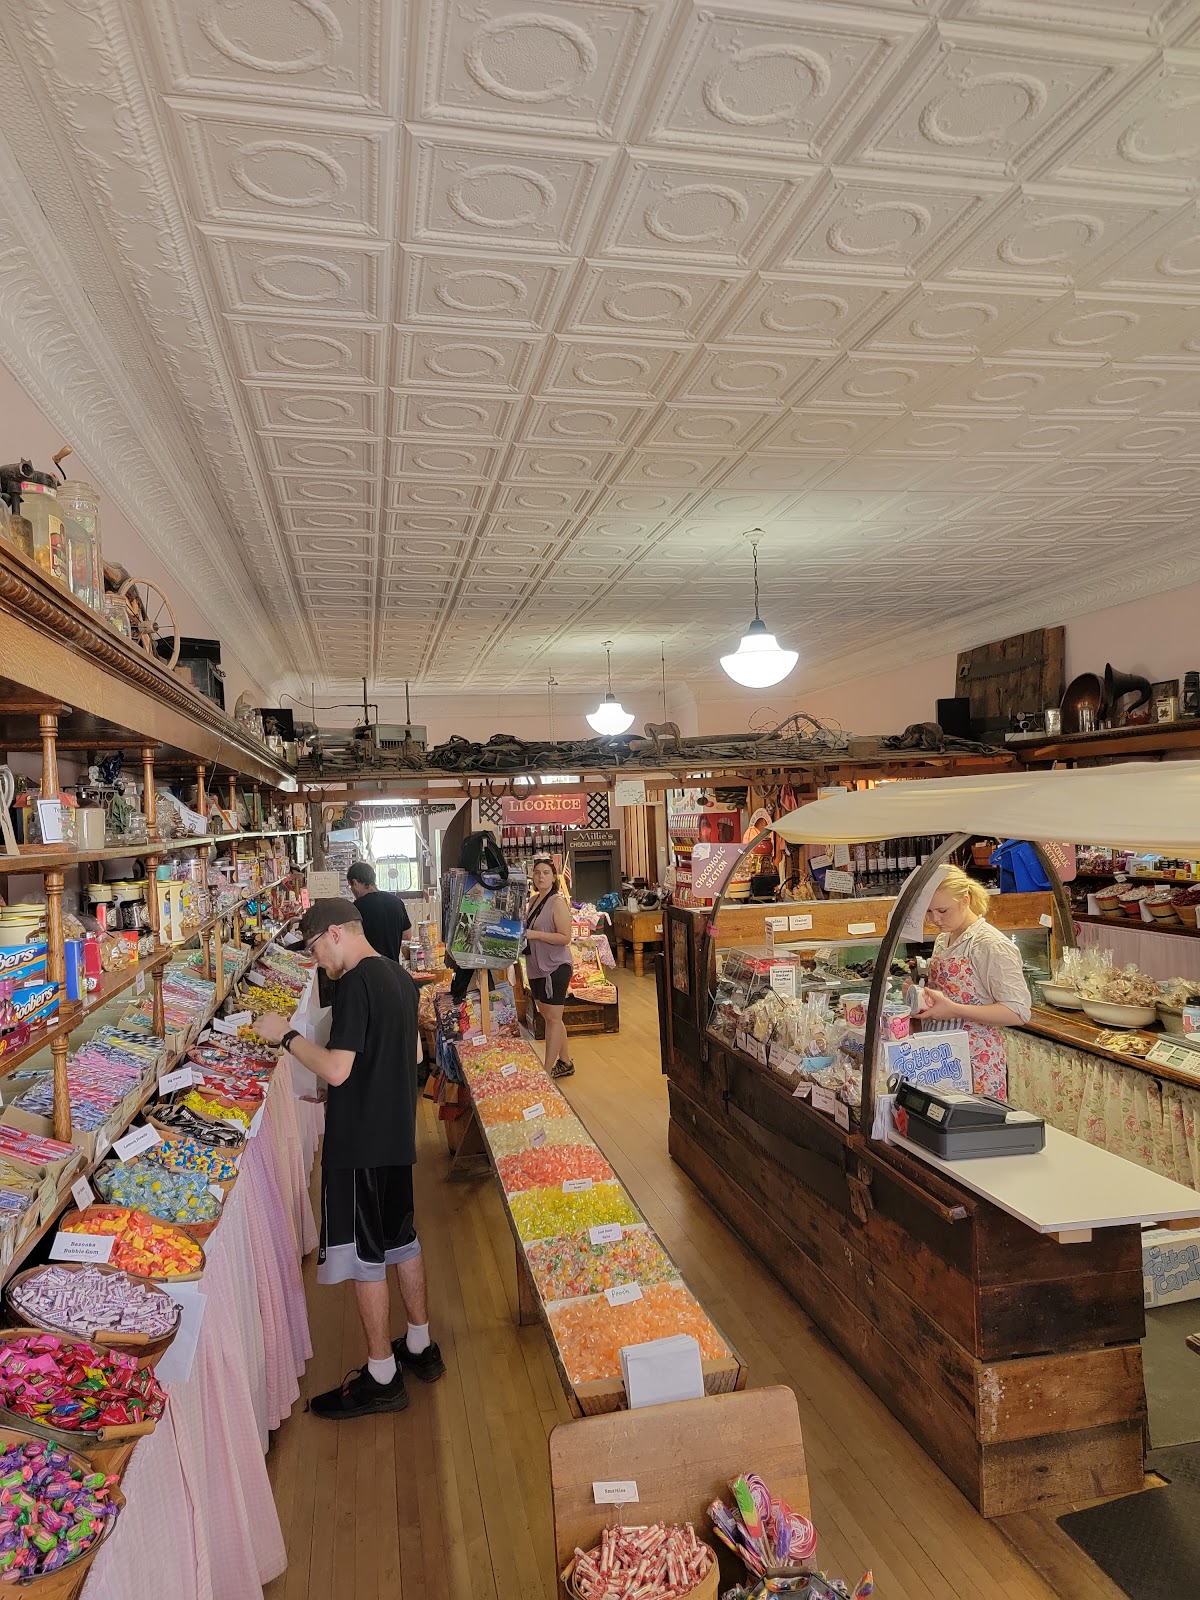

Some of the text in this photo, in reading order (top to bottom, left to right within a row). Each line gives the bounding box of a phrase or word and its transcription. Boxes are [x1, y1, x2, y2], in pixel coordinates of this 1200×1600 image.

[349, 806, 398, 821] SUGAR
[403, 805, 429, 818] FREE
[508, 798, 581, 812] LICORICE
[569, 840, 601, 848] CHOCOLATE
[572, 831, 614, 841] Millie's
[1042, 843, 1062, 869] SECTION
[1049, 841, 1071, 868] OCOHOLIC
[694, 846, 726, 889] CHOCOHOLIC
[705, 859, 729, 889] SECTION
[126, 941, 137, 950] OTS
[0, 947, 35, 971] bers
[892, 1043, 953, 1076] Cotton
[1143, 1244, 1200, 1278] Cotton
